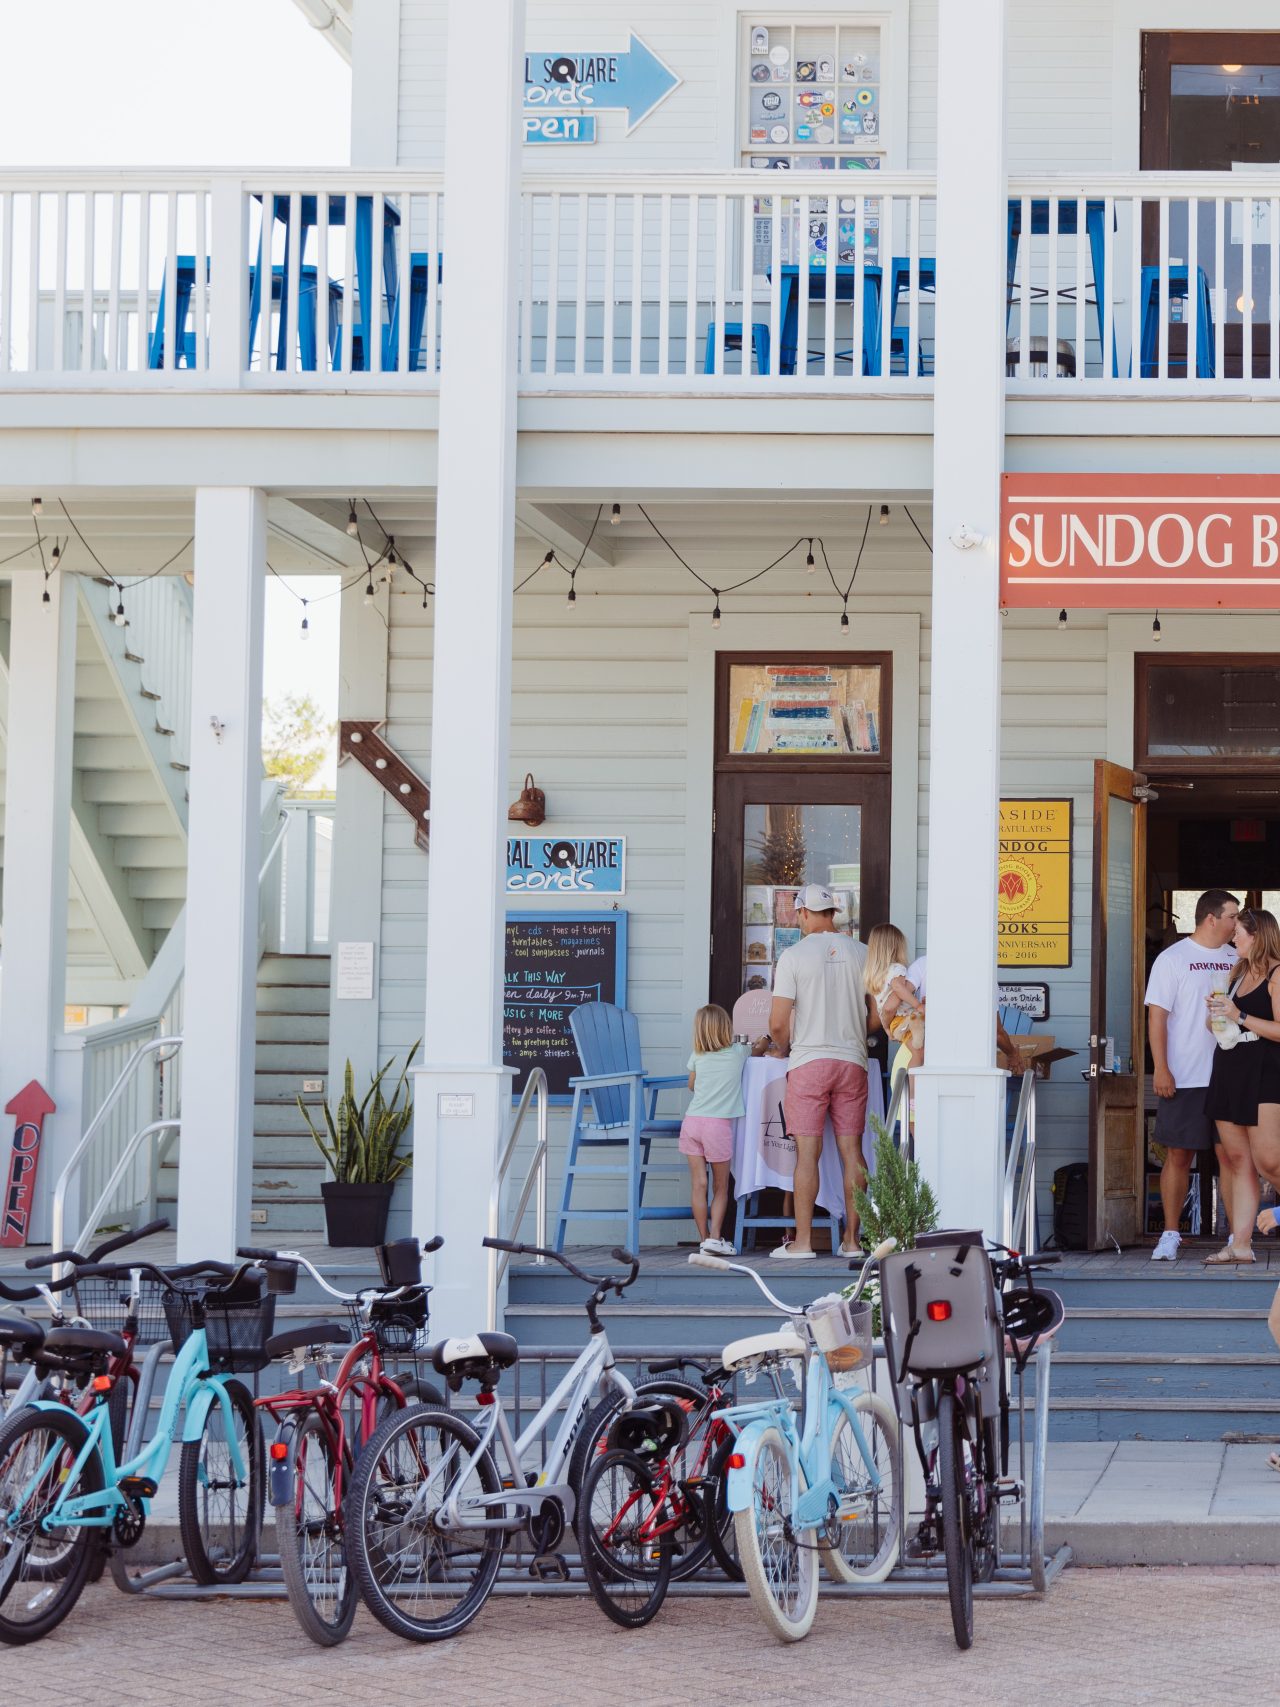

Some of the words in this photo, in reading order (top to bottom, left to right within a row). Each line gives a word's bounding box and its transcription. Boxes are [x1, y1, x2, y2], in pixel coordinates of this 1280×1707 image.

[543, 57, 617, 84] SQUARE
[523, 81, 594, 104] ords
[1008, 512, 1233, 568] SUNDOG
[1000, 841, 1048, 852] NDOG
[543, 841, 618, 869] SQUARE
[507, 867, 594, 890] cords
[528, 925, 542, 935] cds
[552, 925, 568, 936] tons
[571, 925, 579, 935] of
[998, 923, 1038, 934] OOKS
[512, 937, 553, 947] turntables
[560, 937, 601, 947] magazines
[515, 948, 529, 957] cool
[532, 949, 570, 958] sunglasses
[575, 947, 605, 958] journals
[524, 970, 542, 981] THIS
[545, 970, 567, 983] WAY
[525, 988, 562, 1003] daily
[539, 1008, 564, 1022] MORE
[536, 1026, 556, 1035] coffee
[512, 1037, 521, 1046] fun
[524, 1037, 550, 1048] greeting
[551, 1037, 568, 1046] cards
[519, 1050, 537, 1059] amps
[545, 1049, 570, 1058] stickers
